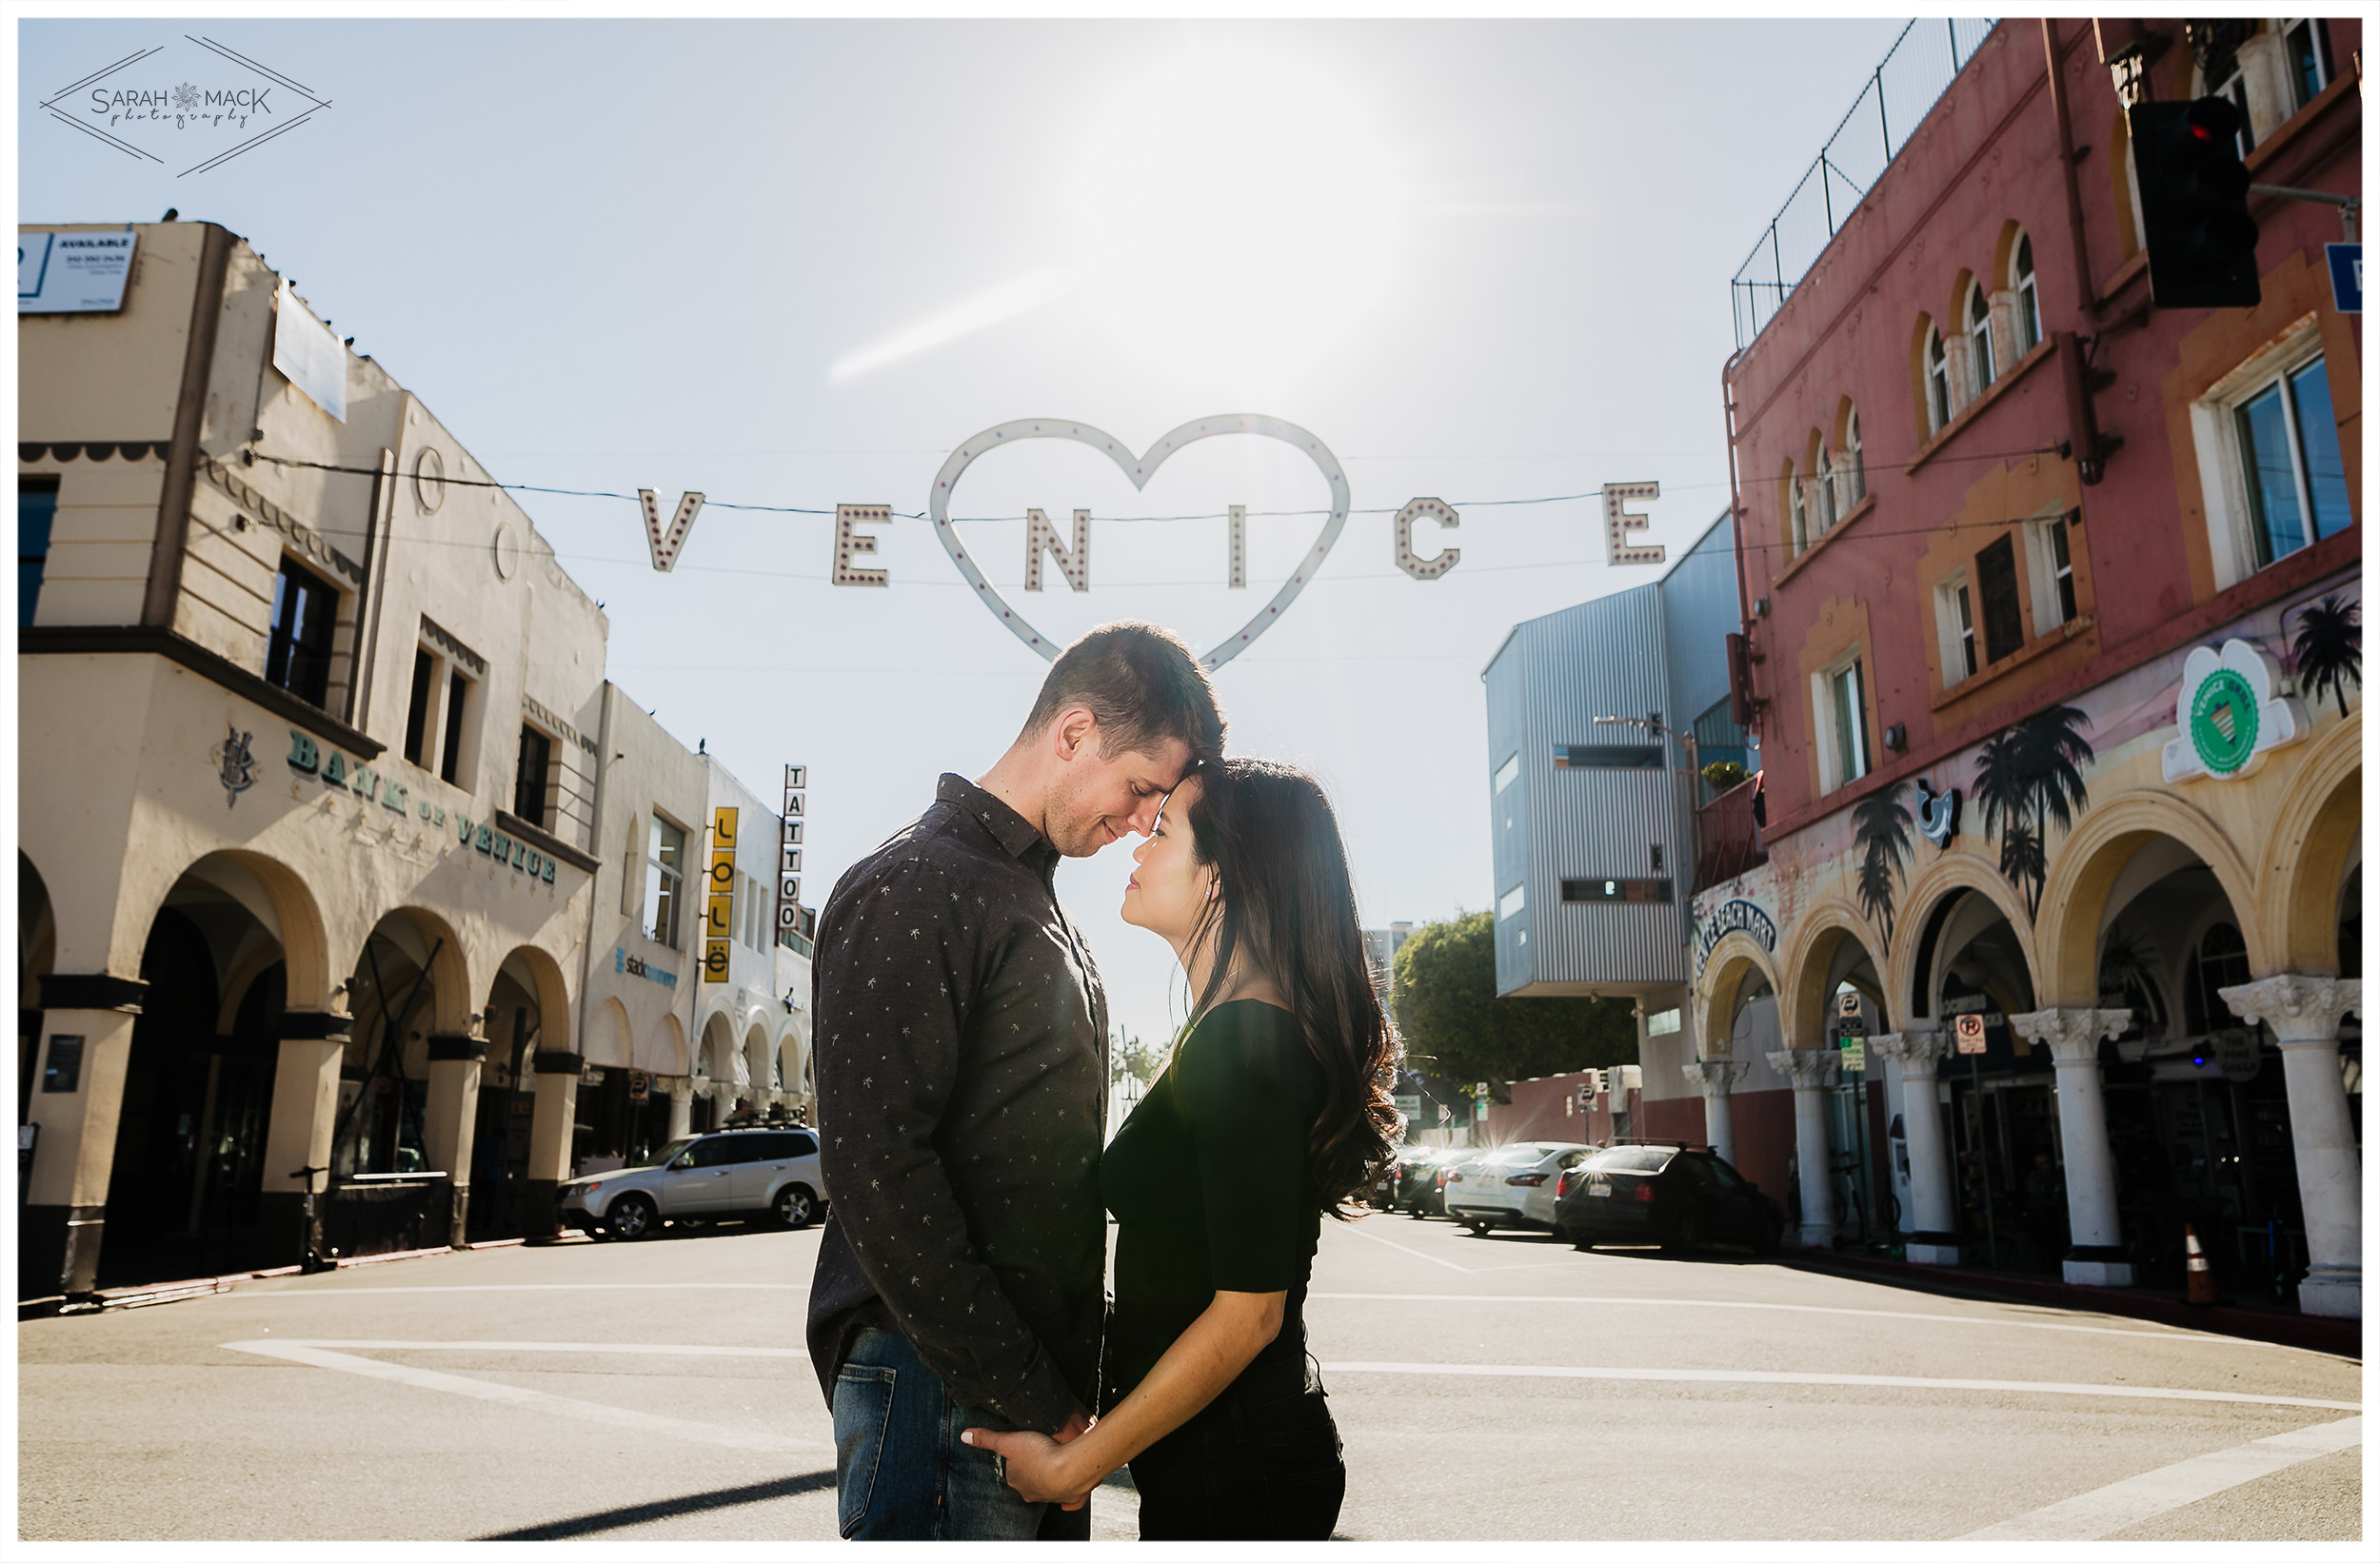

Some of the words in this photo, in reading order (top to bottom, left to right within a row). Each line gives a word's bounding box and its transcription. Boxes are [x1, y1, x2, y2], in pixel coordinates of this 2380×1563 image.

[60, 239, 129, 248] AVAILABLE
[637, 481, 1665, 593] VENICE
[2196, 679, 2226, 717] VENICE
[2228, 680, 2251, 713] GRILL
[288, 730, 407, 820] BANK
[455, 813, 557, 886] VENICE
[782, 767, 802, 925] TATTOO
[1716, 902, 1745, 938] BEACH
[1745, 904, 1775, 954] MART
